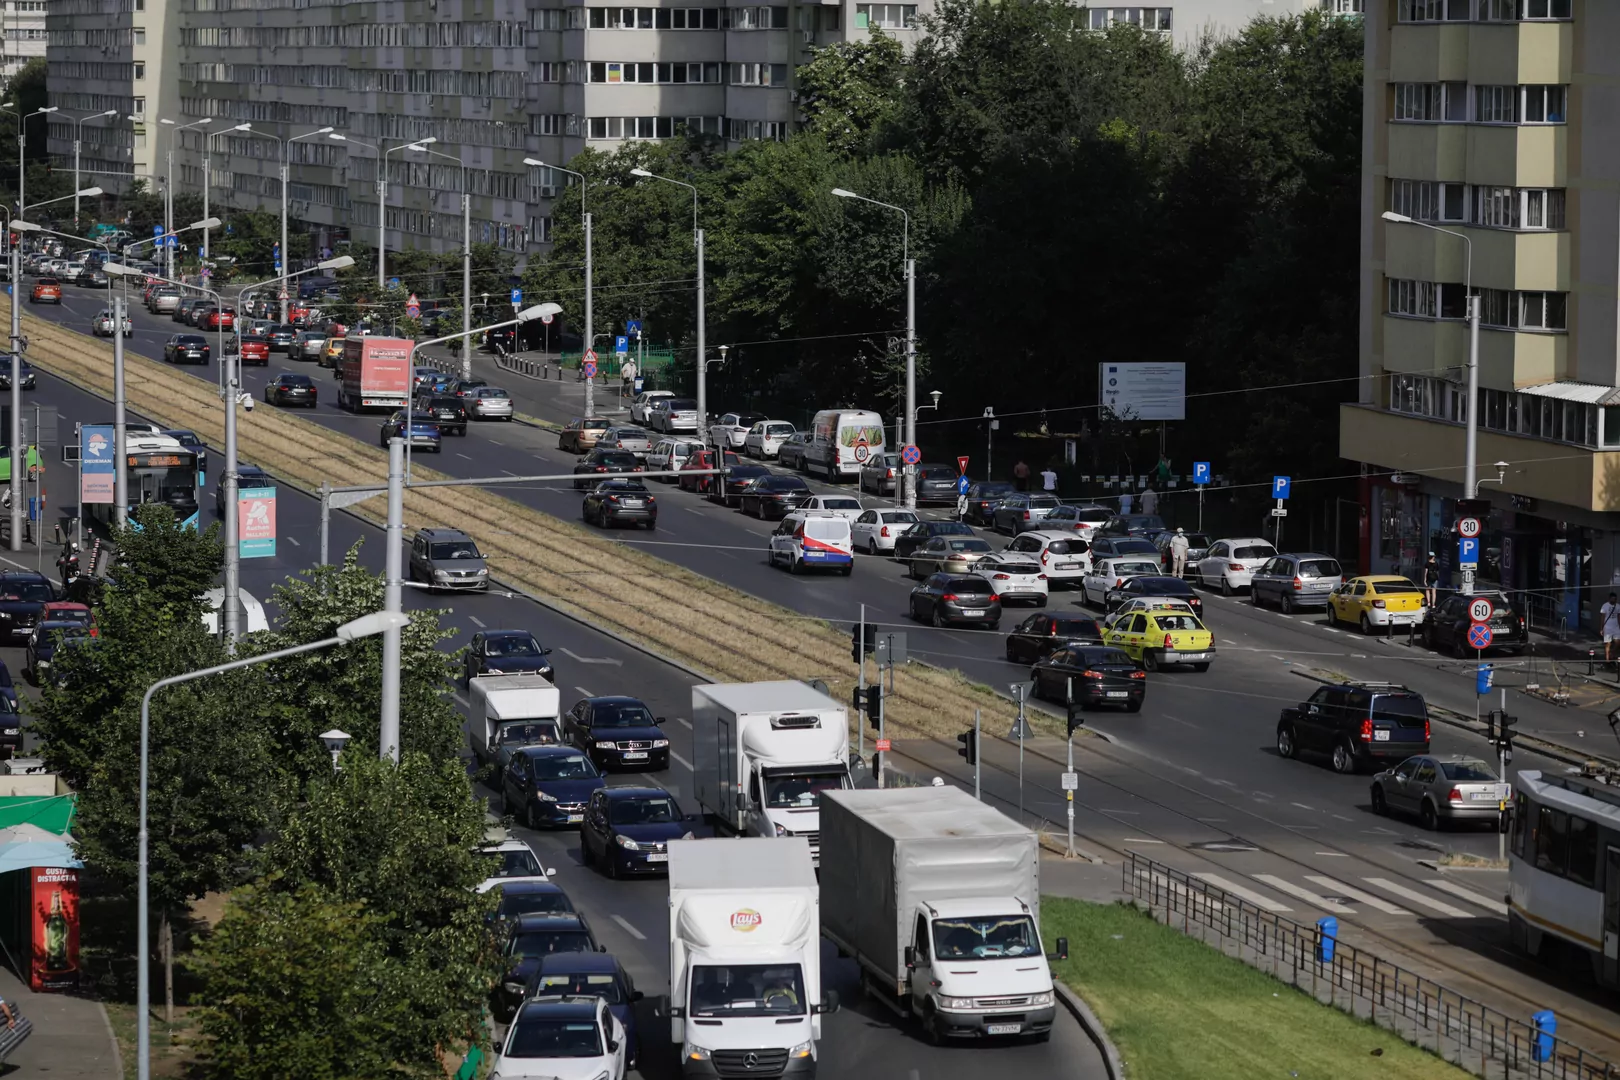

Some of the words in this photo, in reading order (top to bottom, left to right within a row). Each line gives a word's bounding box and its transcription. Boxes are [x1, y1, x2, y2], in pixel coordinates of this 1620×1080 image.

[513, 290, 520, 299] P
[618, 338, 626, 347] P
[857, 448, 867, 459] 30
[128, 457, 138, 467] 104
[1197, 463, 1207, 477] P
[1276, 478, 1287, 492] P
[1463, 521, 1476, 533] 30
[1463, 540, 1475, 555] P
[1474, 604, 1489, 617] 60
